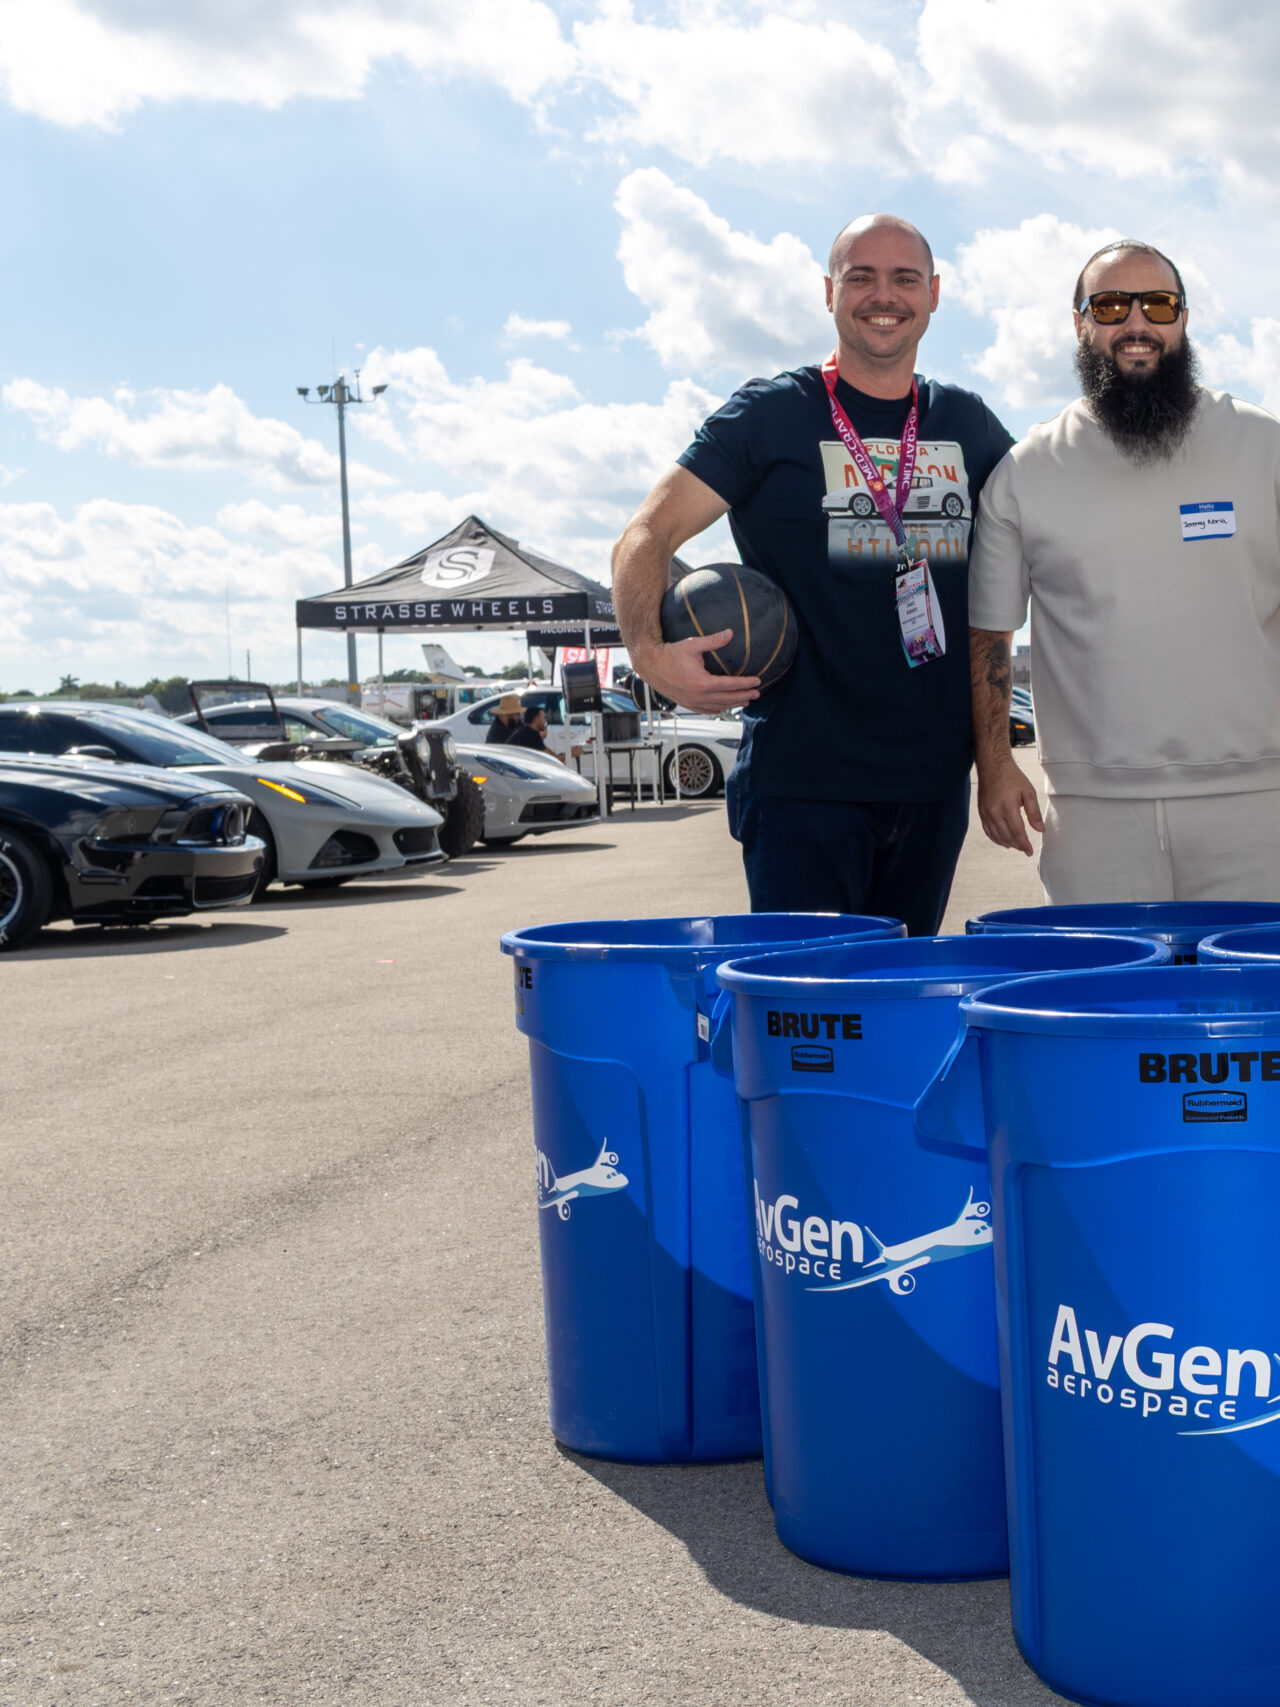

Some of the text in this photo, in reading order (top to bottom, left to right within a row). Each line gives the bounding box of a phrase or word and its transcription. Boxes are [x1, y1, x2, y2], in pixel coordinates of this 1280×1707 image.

[335, 600, 554, 620] STRASSE WHEELS
[767, 1010, 863, 1040] BRUTE
[1187, 1098, 1243, 1108] Rubbermaid
[757, 1234, 842, 1280] erospace
[1047, 1303, 1271, 1398] AvGen
[1046, 1366, 1237, 1421] aerospace
